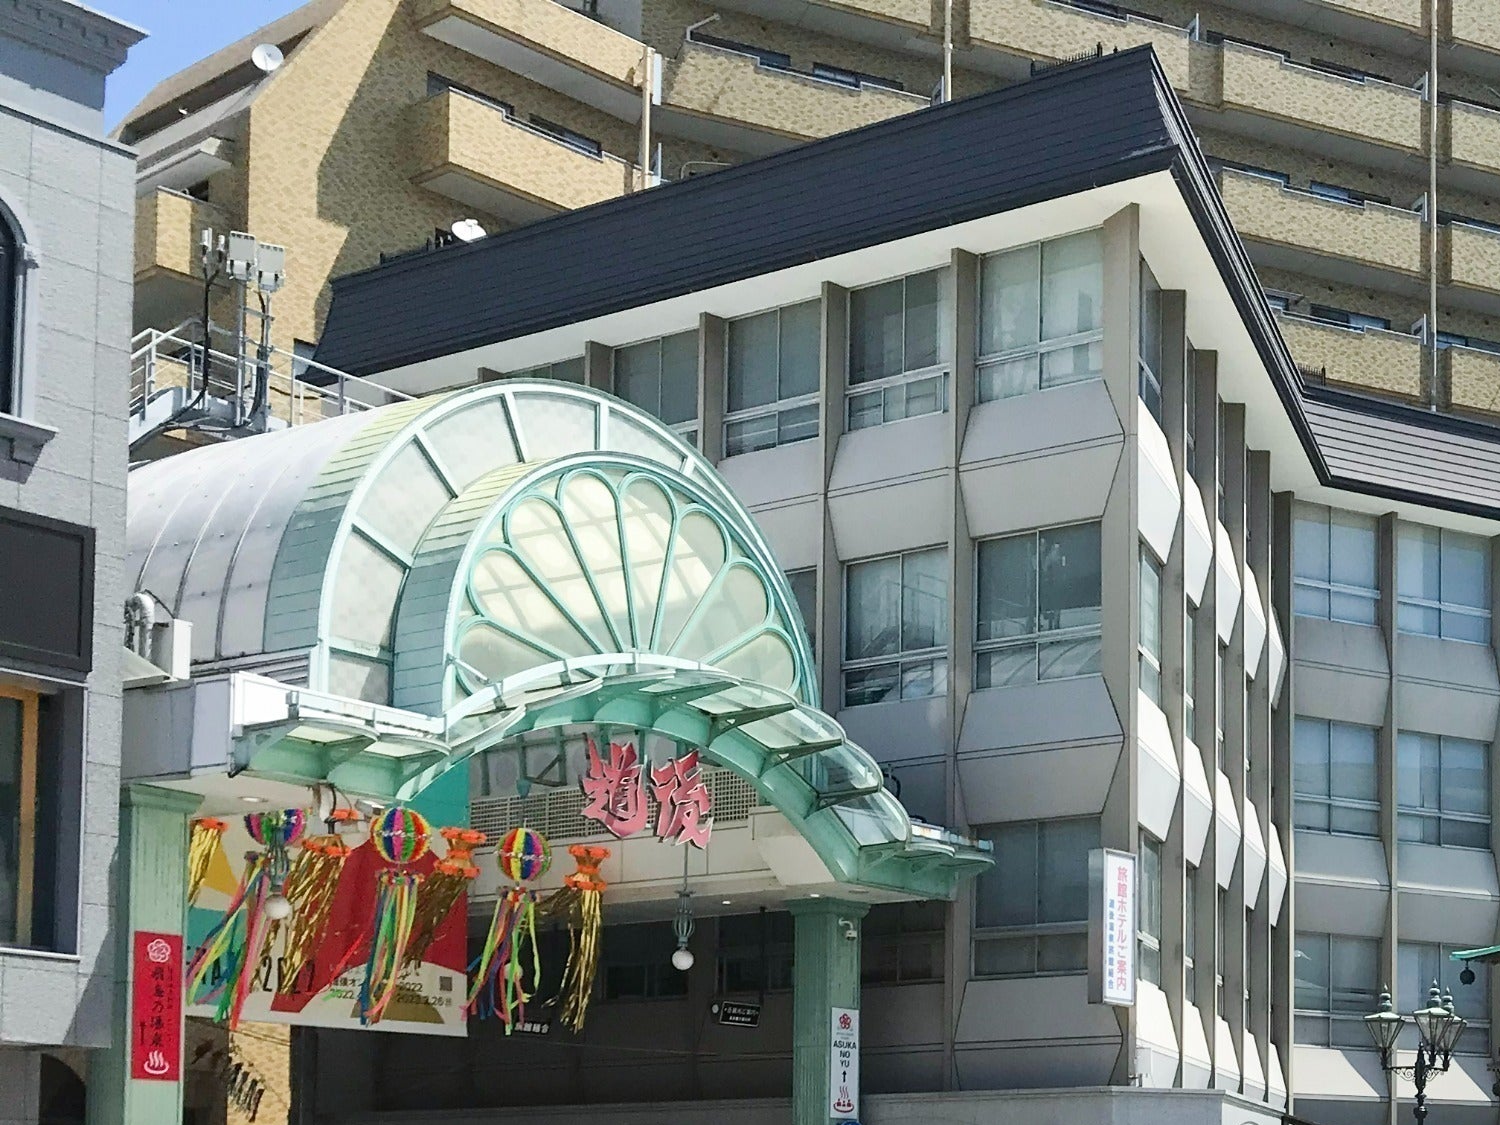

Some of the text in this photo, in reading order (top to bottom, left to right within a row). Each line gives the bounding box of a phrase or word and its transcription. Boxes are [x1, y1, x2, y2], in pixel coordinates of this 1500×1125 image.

[1116, 867, 1129, 991] 旅館ホテルご案内
[833, 1041, 856, 1049] ASUKA
[840, 1050, 850, 1058] NO
